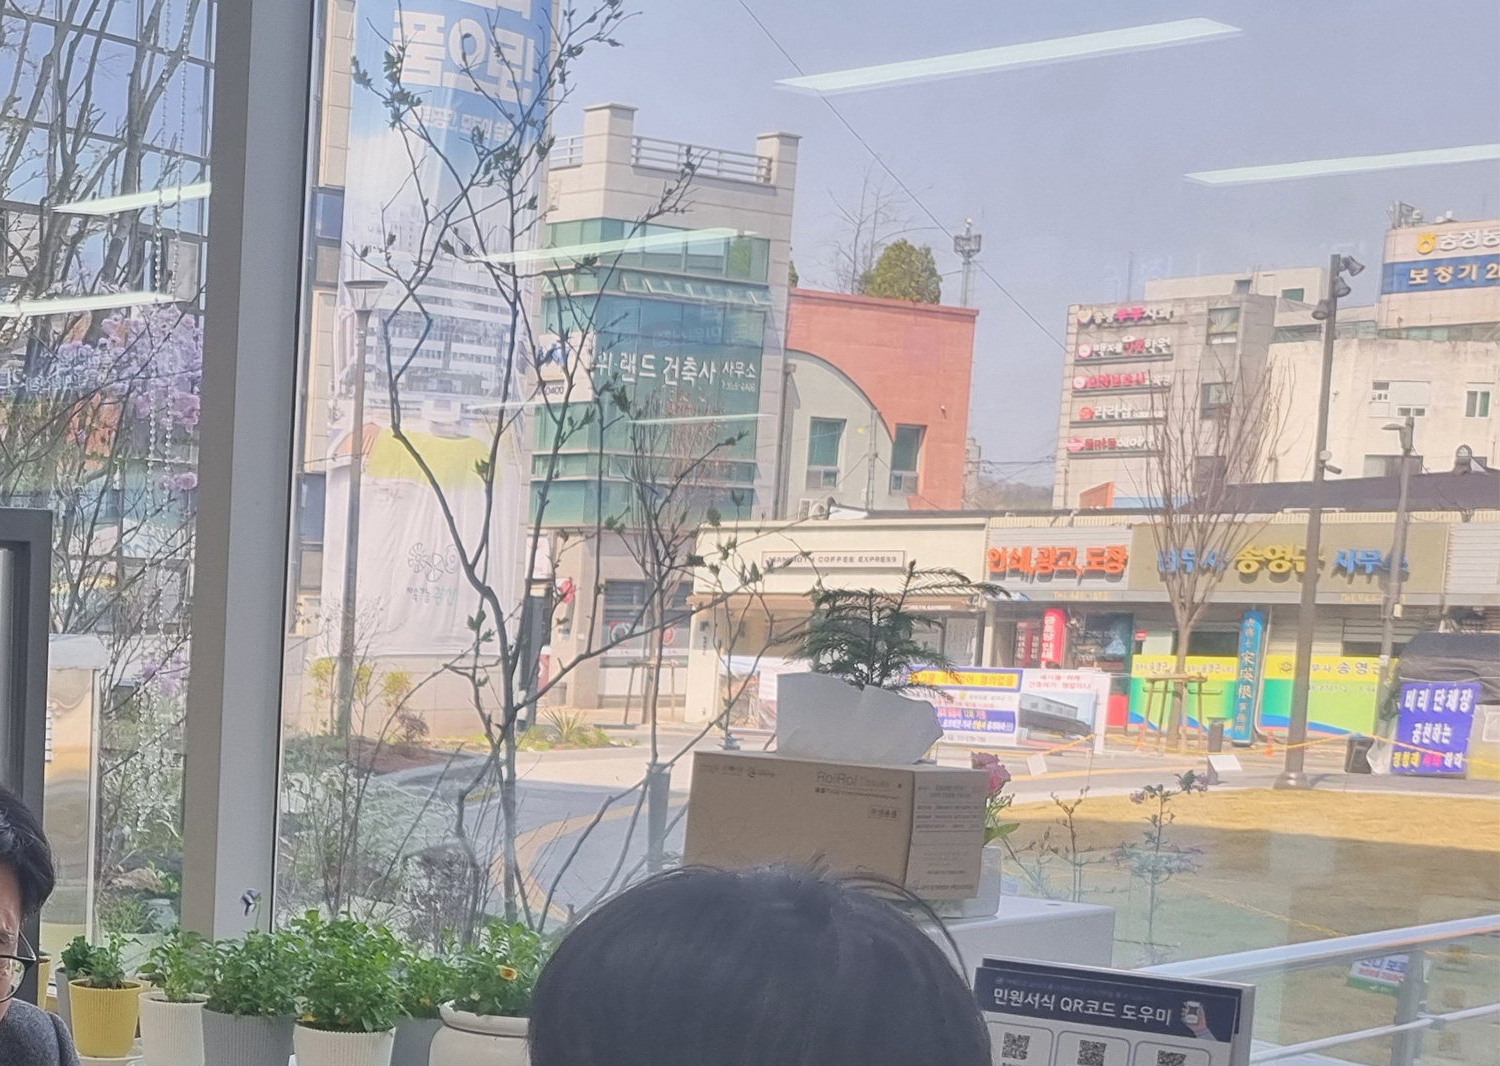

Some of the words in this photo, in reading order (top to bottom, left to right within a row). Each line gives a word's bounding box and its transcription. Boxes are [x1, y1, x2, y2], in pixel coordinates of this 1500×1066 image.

[1408, 263, 1479, 285] 보청기
[1485, 263, 1500, 279] 2
[663, 355, 717, 387] 건축사
[722, 359, 757, 379] 사무소
[858, 556, 897, 564] EXPRESS
[993, 988, 1056, 1011] 민원서식
[1060, 996, 1116, 1018] QR코드
[1121, 1004, 1172, 1026] 도우미
